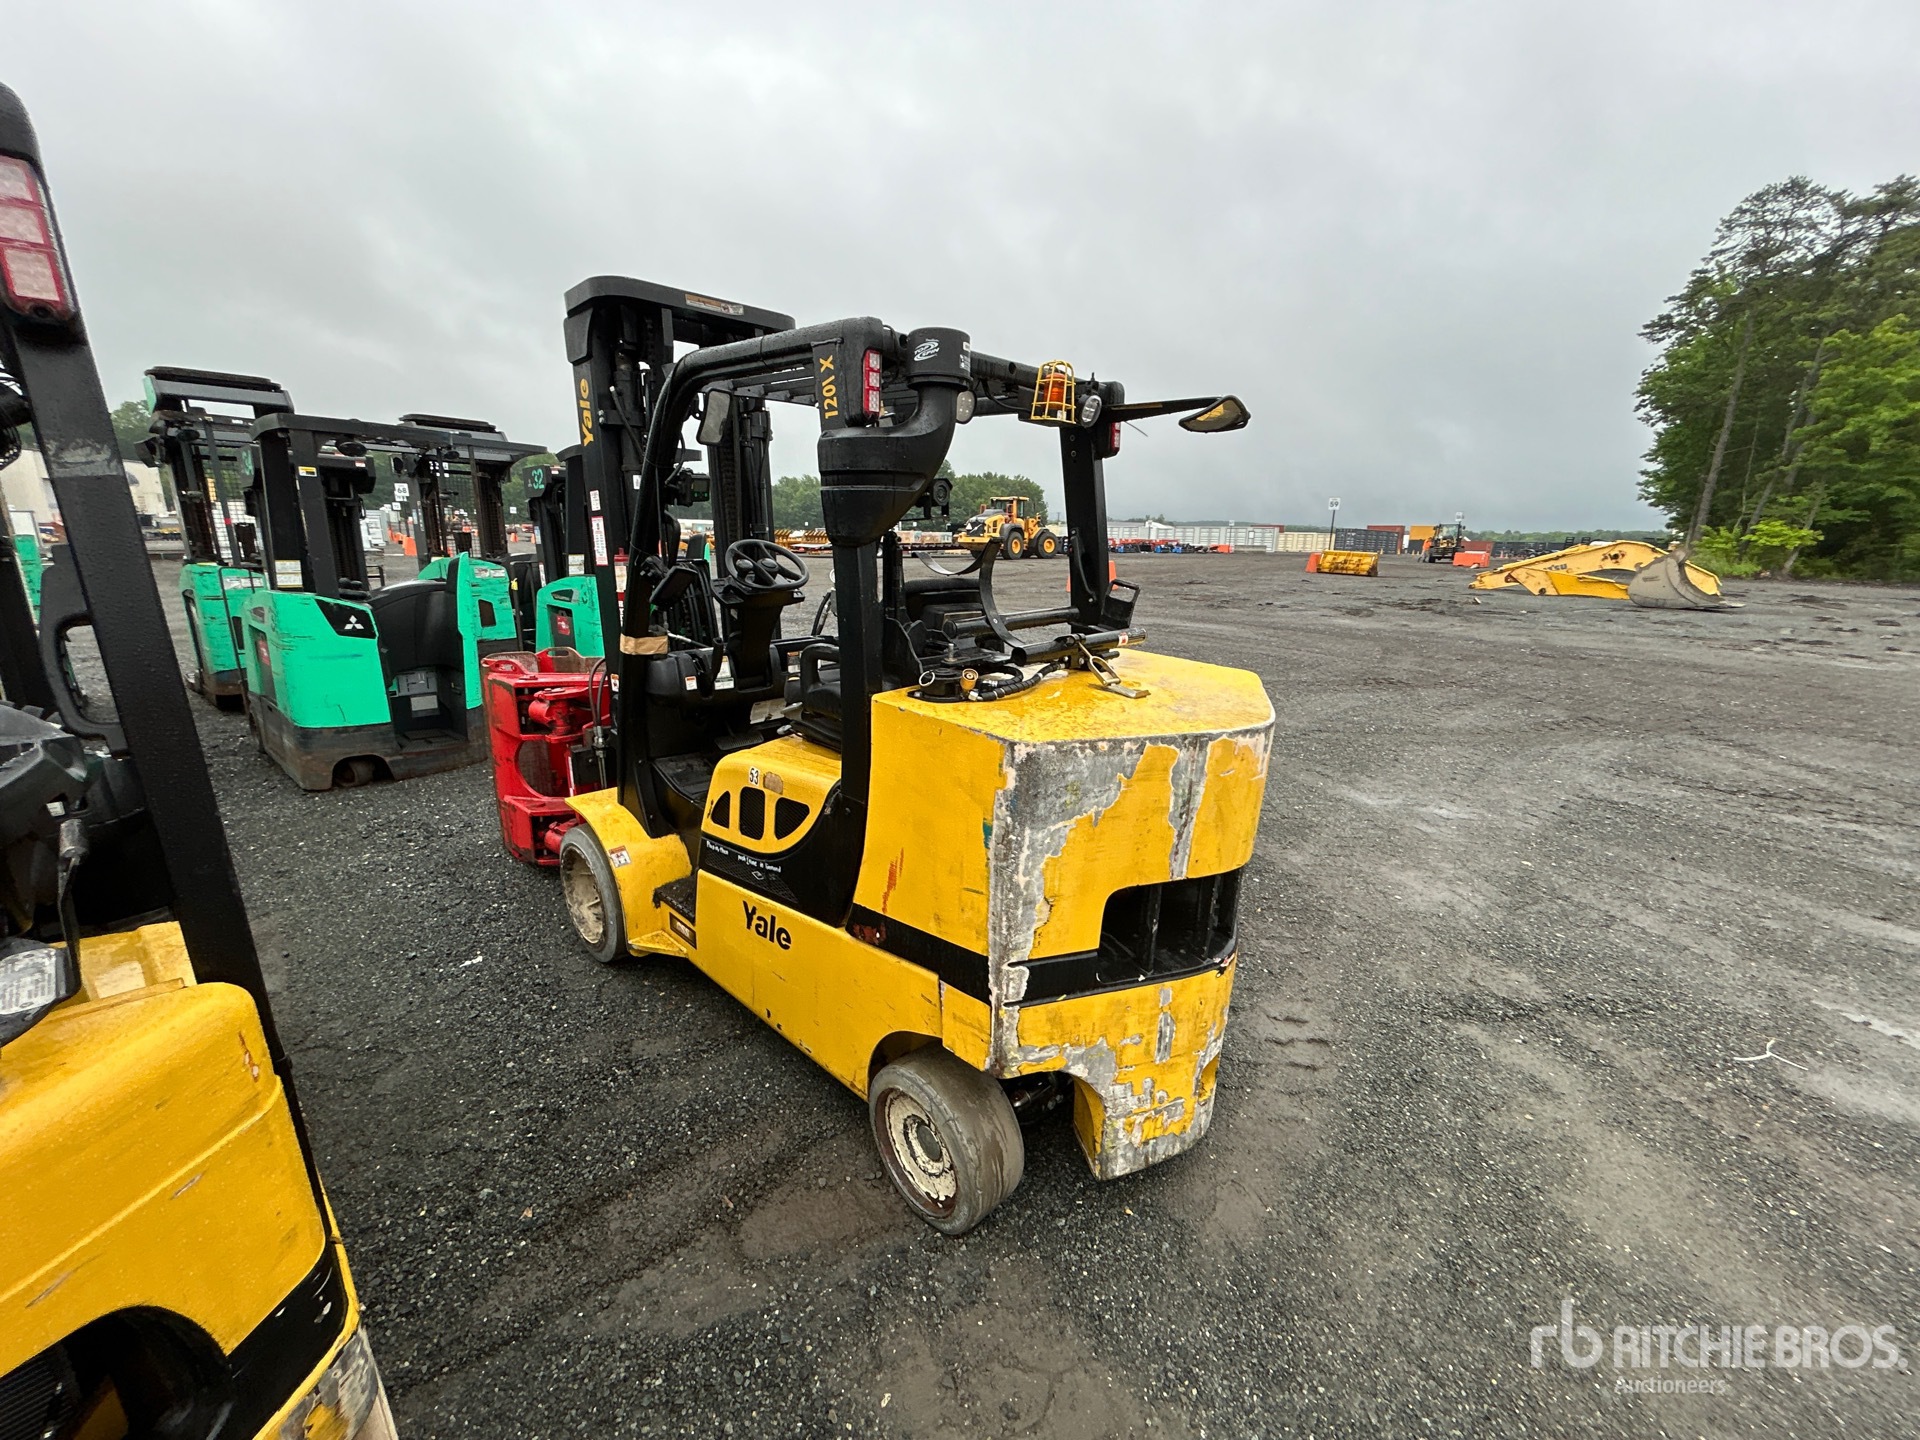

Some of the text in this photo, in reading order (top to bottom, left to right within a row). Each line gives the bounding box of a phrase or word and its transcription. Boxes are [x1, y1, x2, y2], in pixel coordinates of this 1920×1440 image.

[579, 378, 594, 446] Yale
[532, 467, 545, 490] 32
[749, 767, 759, 785] 53
[742, 900, 792, 950] Yale
